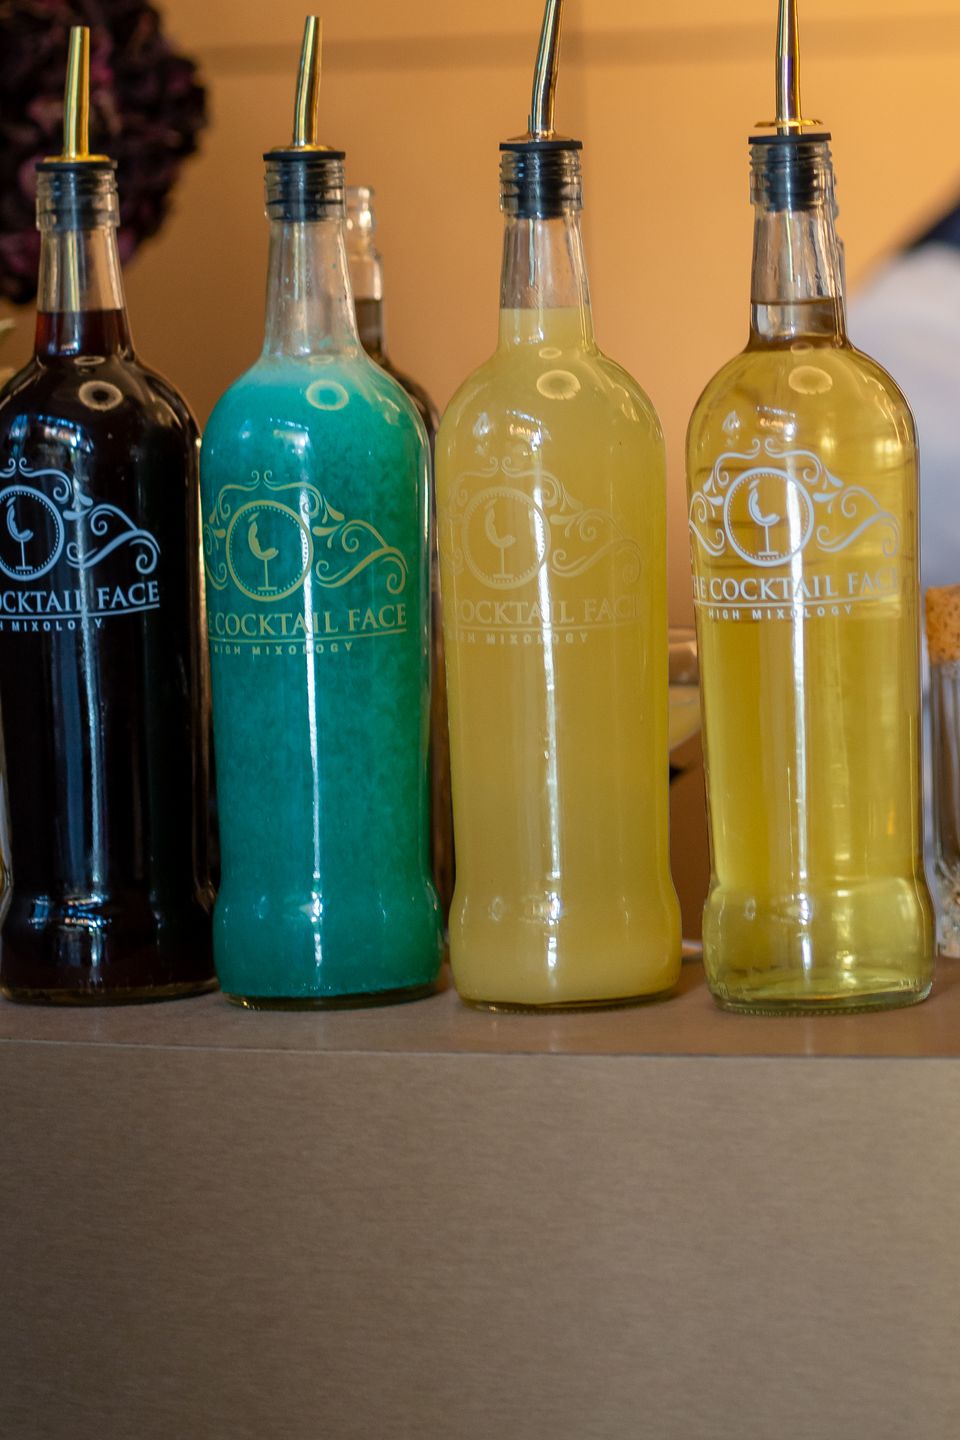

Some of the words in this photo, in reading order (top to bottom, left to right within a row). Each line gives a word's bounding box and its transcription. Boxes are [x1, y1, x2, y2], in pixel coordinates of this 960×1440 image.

[0, 589, 86, 613] CKTAIL
[97, 580, 160, 610] FACE
[710, 575, 838, 601] COCKTAIL
[215, 610, 339, 637] COCKTAIL
[348, 602, 407, 632] FACE
[451, 598, 575, 625] OCKTAIL
[708, 607, 740, 620] HIGH
[752, 604, 853, 620] MIXOLOGY
